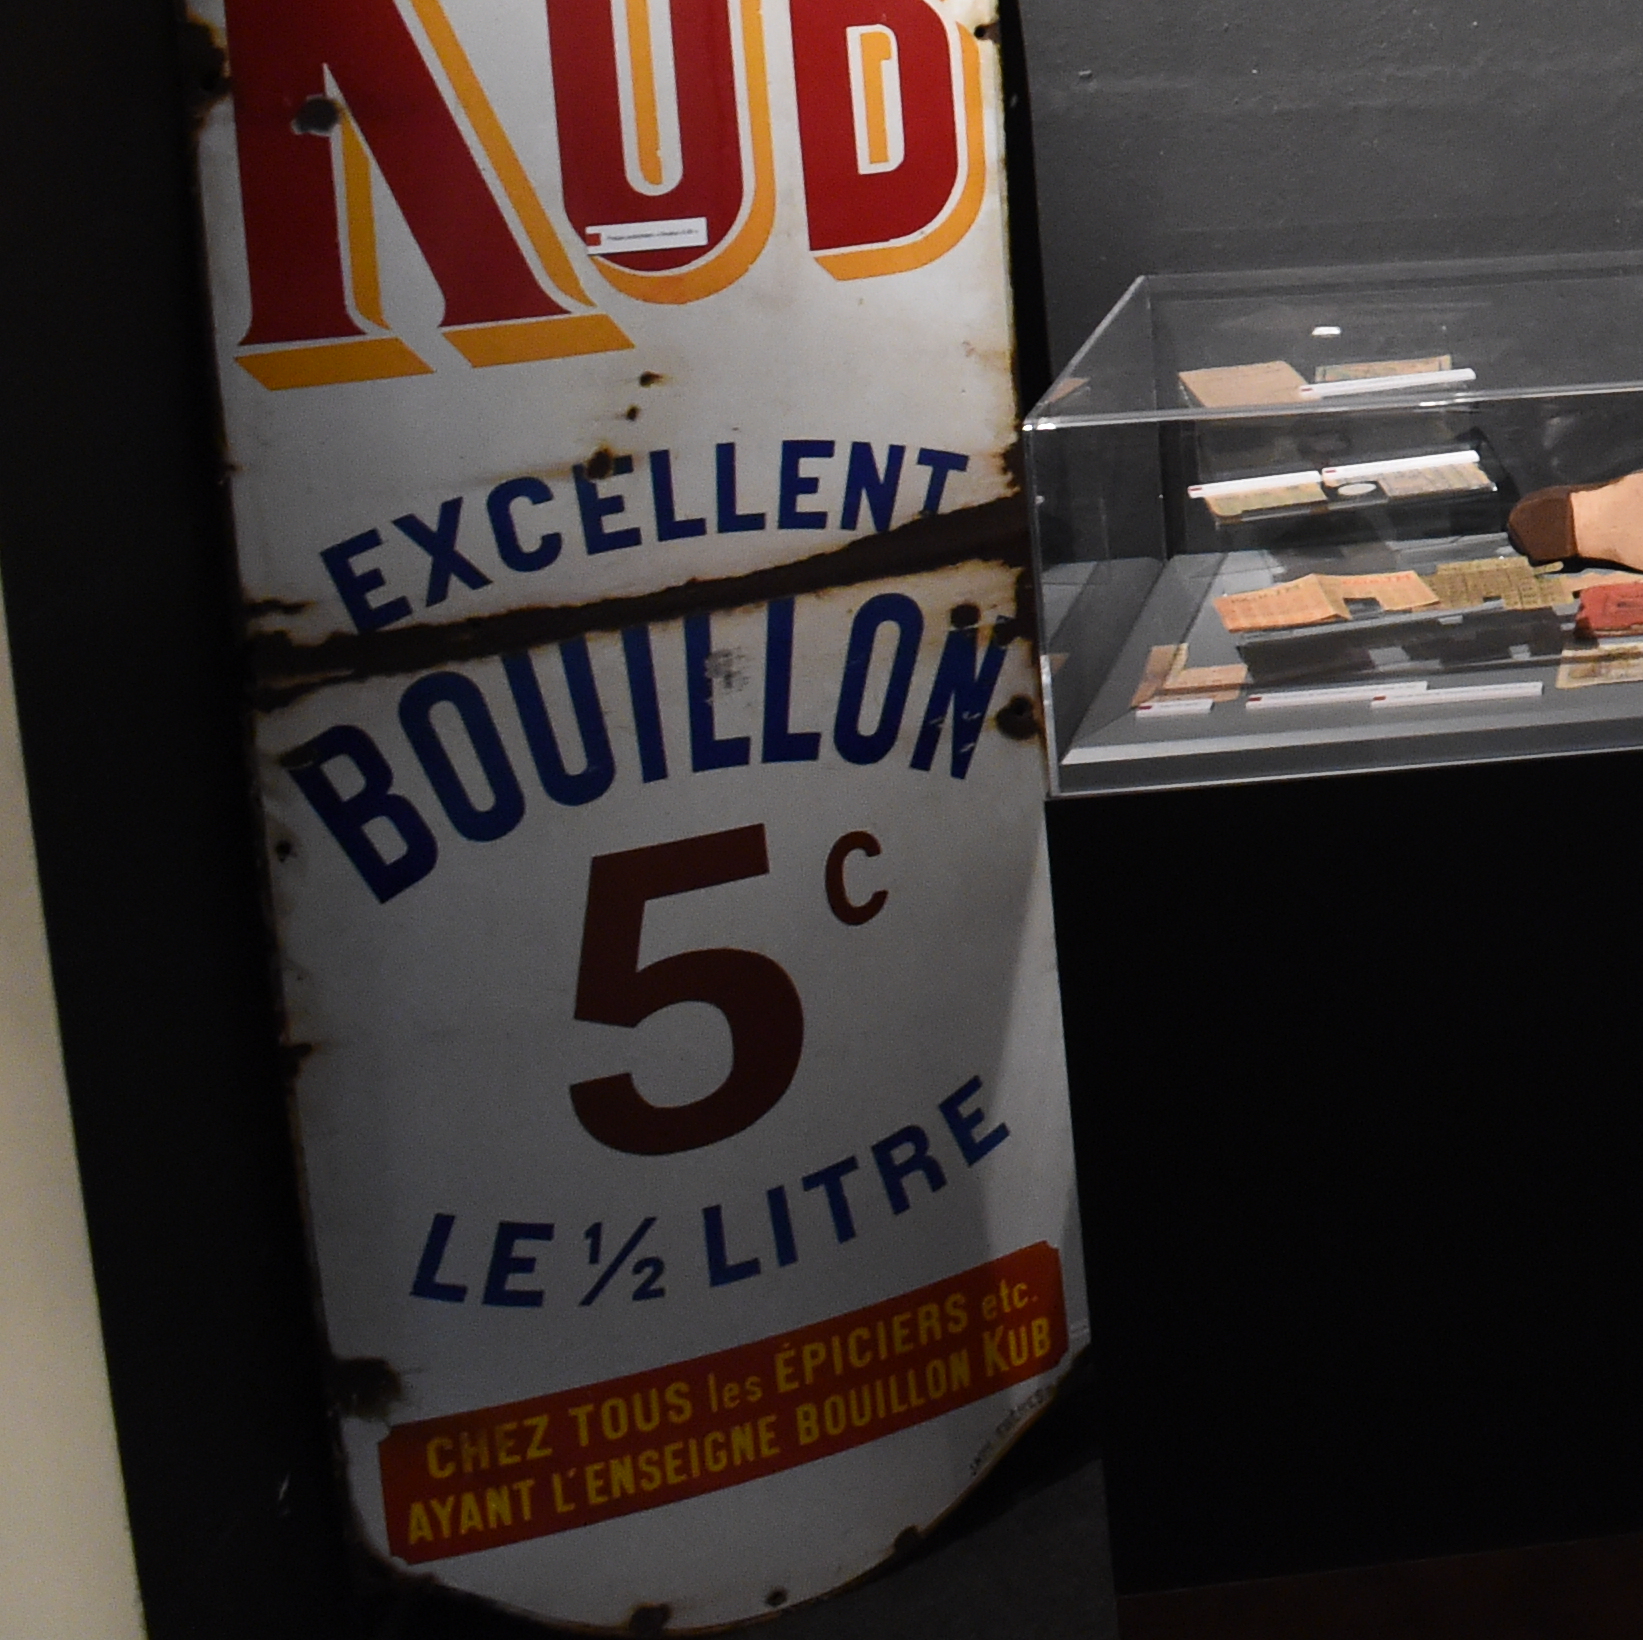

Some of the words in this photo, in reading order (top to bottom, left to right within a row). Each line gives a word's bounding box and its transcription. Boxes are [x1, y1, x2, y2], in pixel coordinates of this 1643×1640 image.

[319, 437, 970, 634] EXCELLENT
[287, 591, 1010, 906] BOUILLON
[567, 821, 805, 1158] 5
[409, 1212, 556, 1309] LE
[700, 1074, 1011, 1291] LITRE
[406, 1477, 535, 1548] AYANT
[552, 1418, 782, 1513] L'ENSEIGNE
[796, 1349, 973, 1446] BOUILLON
[983, 1314, 1053, 1391] KUB
[426, 1414, 555, 1481] CHEZ
[568, 1376, 696, 1451] TOUS
[708, 1369, 763, 1414] les
[774, 1293, 969, 1394] ÉPICIERS
[980, 1276, 1038, 1326] etc.
